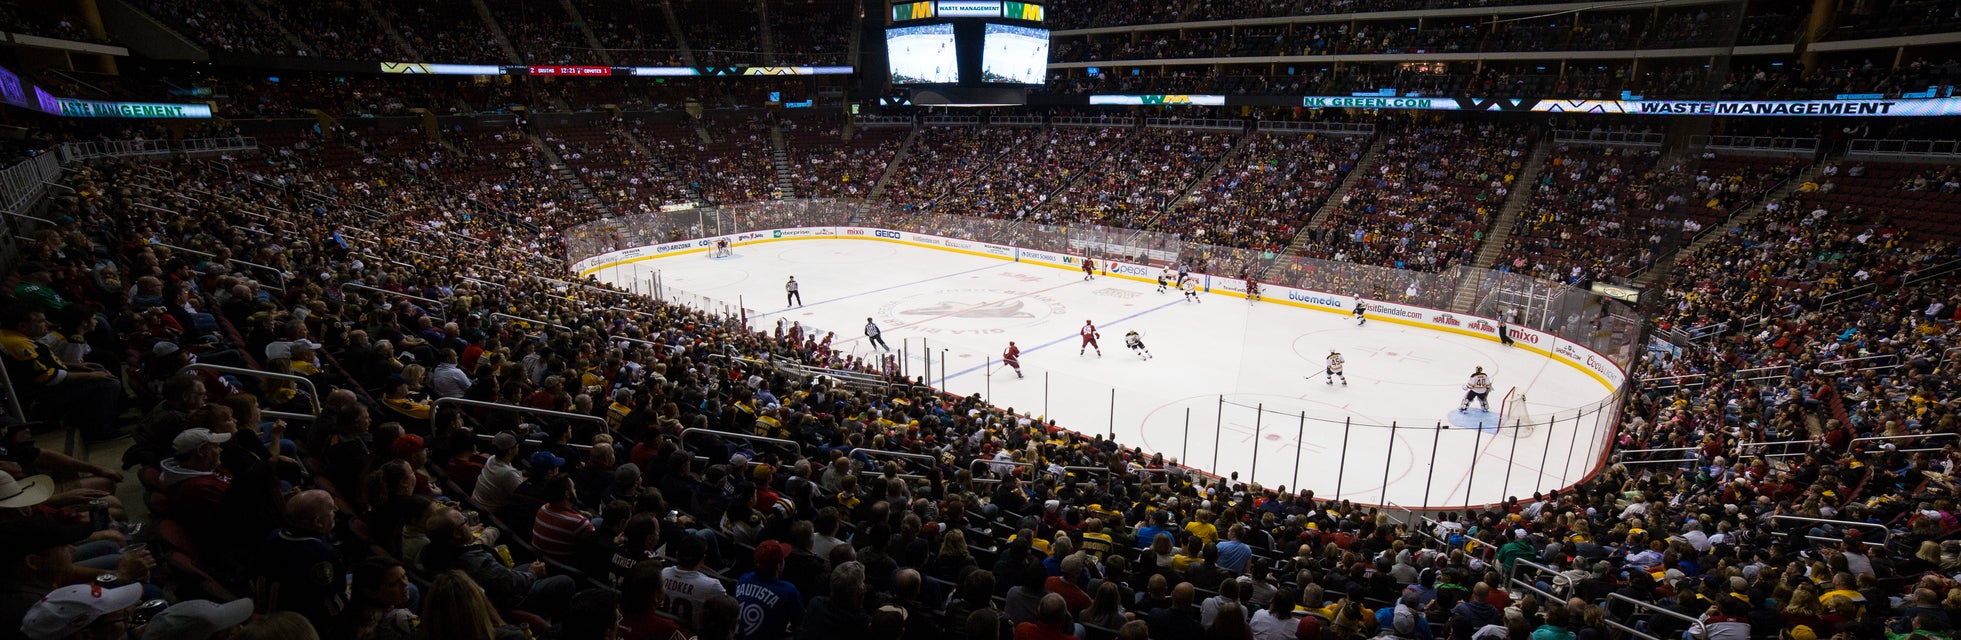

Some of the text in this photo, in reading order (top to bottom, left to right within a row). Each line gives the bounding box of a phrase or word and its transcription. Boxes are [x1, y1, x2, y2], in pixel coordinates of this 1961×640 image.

[896, 1, 932, 19] WM
[1005, 1, 1041, 21] WM
[60, 102, 91, 116] ASTE
[1304, 97, 1432, 108] NK GREEN.COM
[1640, 102, 1896, 115] WASTE MANAGEMENT
[875, 229, 901, 240] GEICO
[670, 243, 691, 251] ARIZONA
[1120, 264, 1148, 276] pepsi
[1289, 290, 1341, 308] bluemedia
[1476, 379, 1486, 387] 40
[735, 583, 780, 608] BAUTISTA
[734, 601, 765, 637] 19
